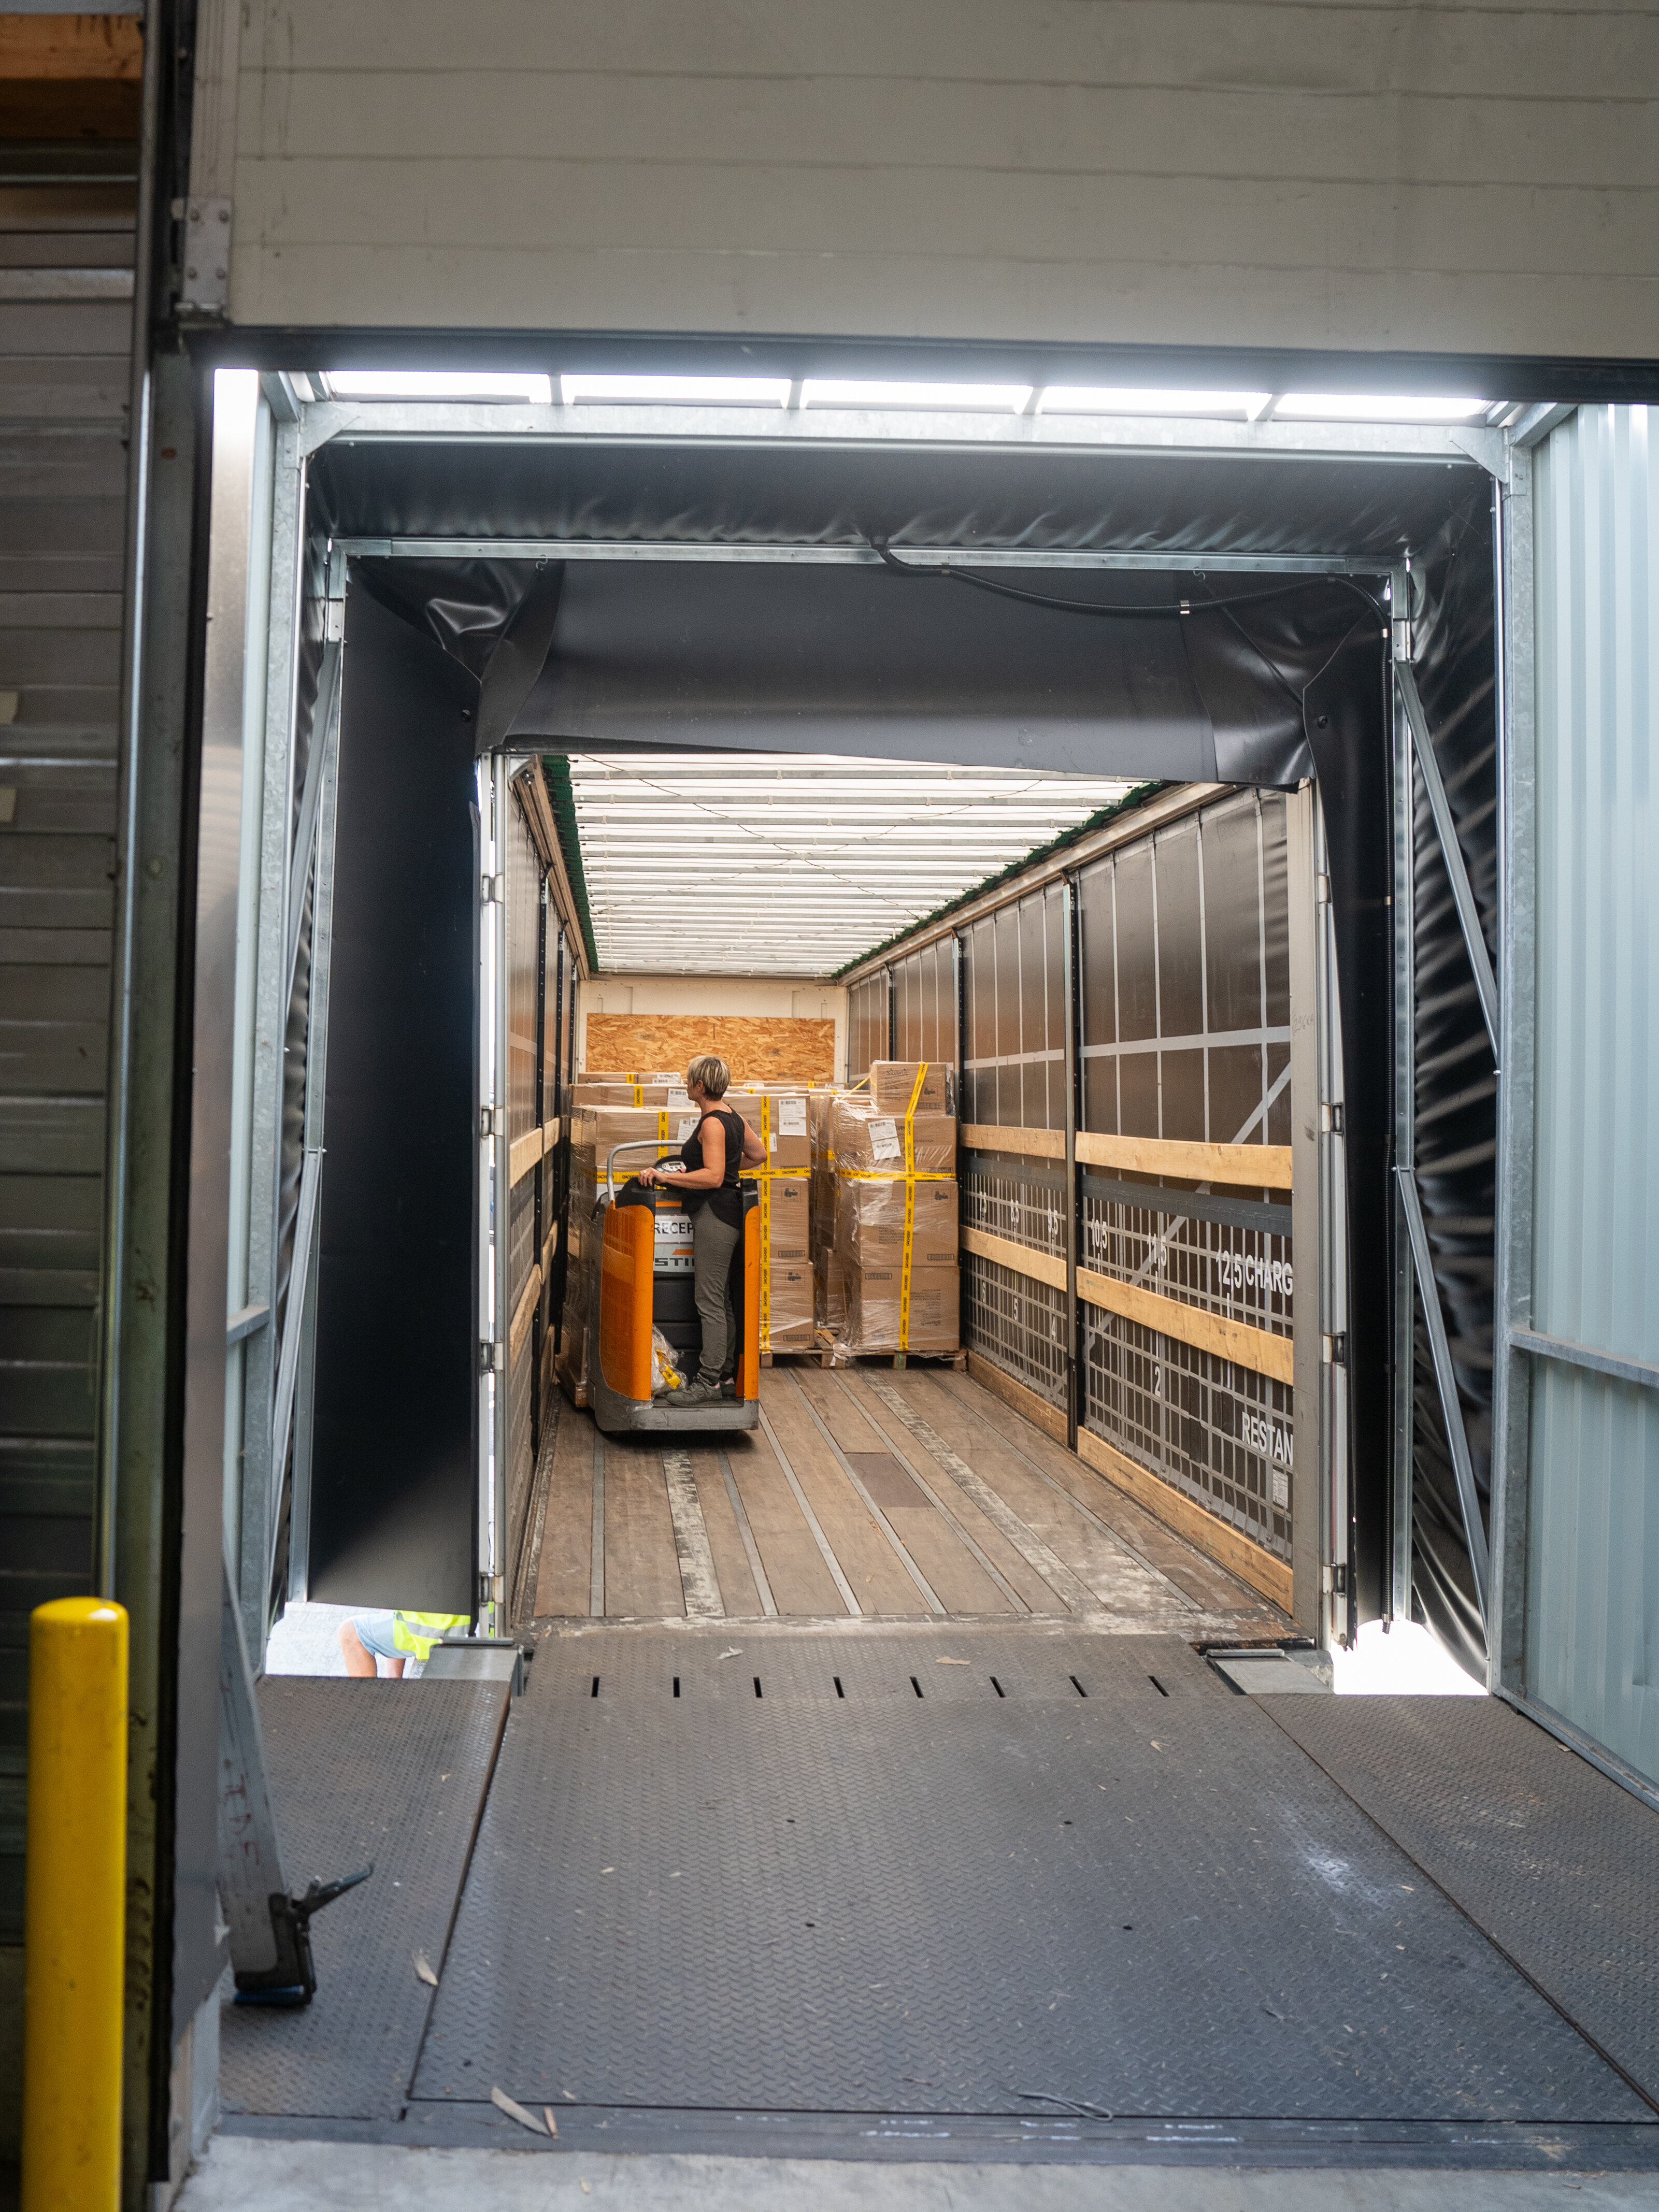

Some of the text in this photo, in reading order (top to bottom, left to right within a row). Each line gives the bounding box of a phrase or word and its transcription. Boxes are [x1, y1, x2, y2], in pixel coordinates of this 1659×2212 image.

[1216, 1249, 1242, 1291] 12,5
[1154, 1366, 1161, 1398] 2
[1242, 1411, 1293, 1467] RESTAN
